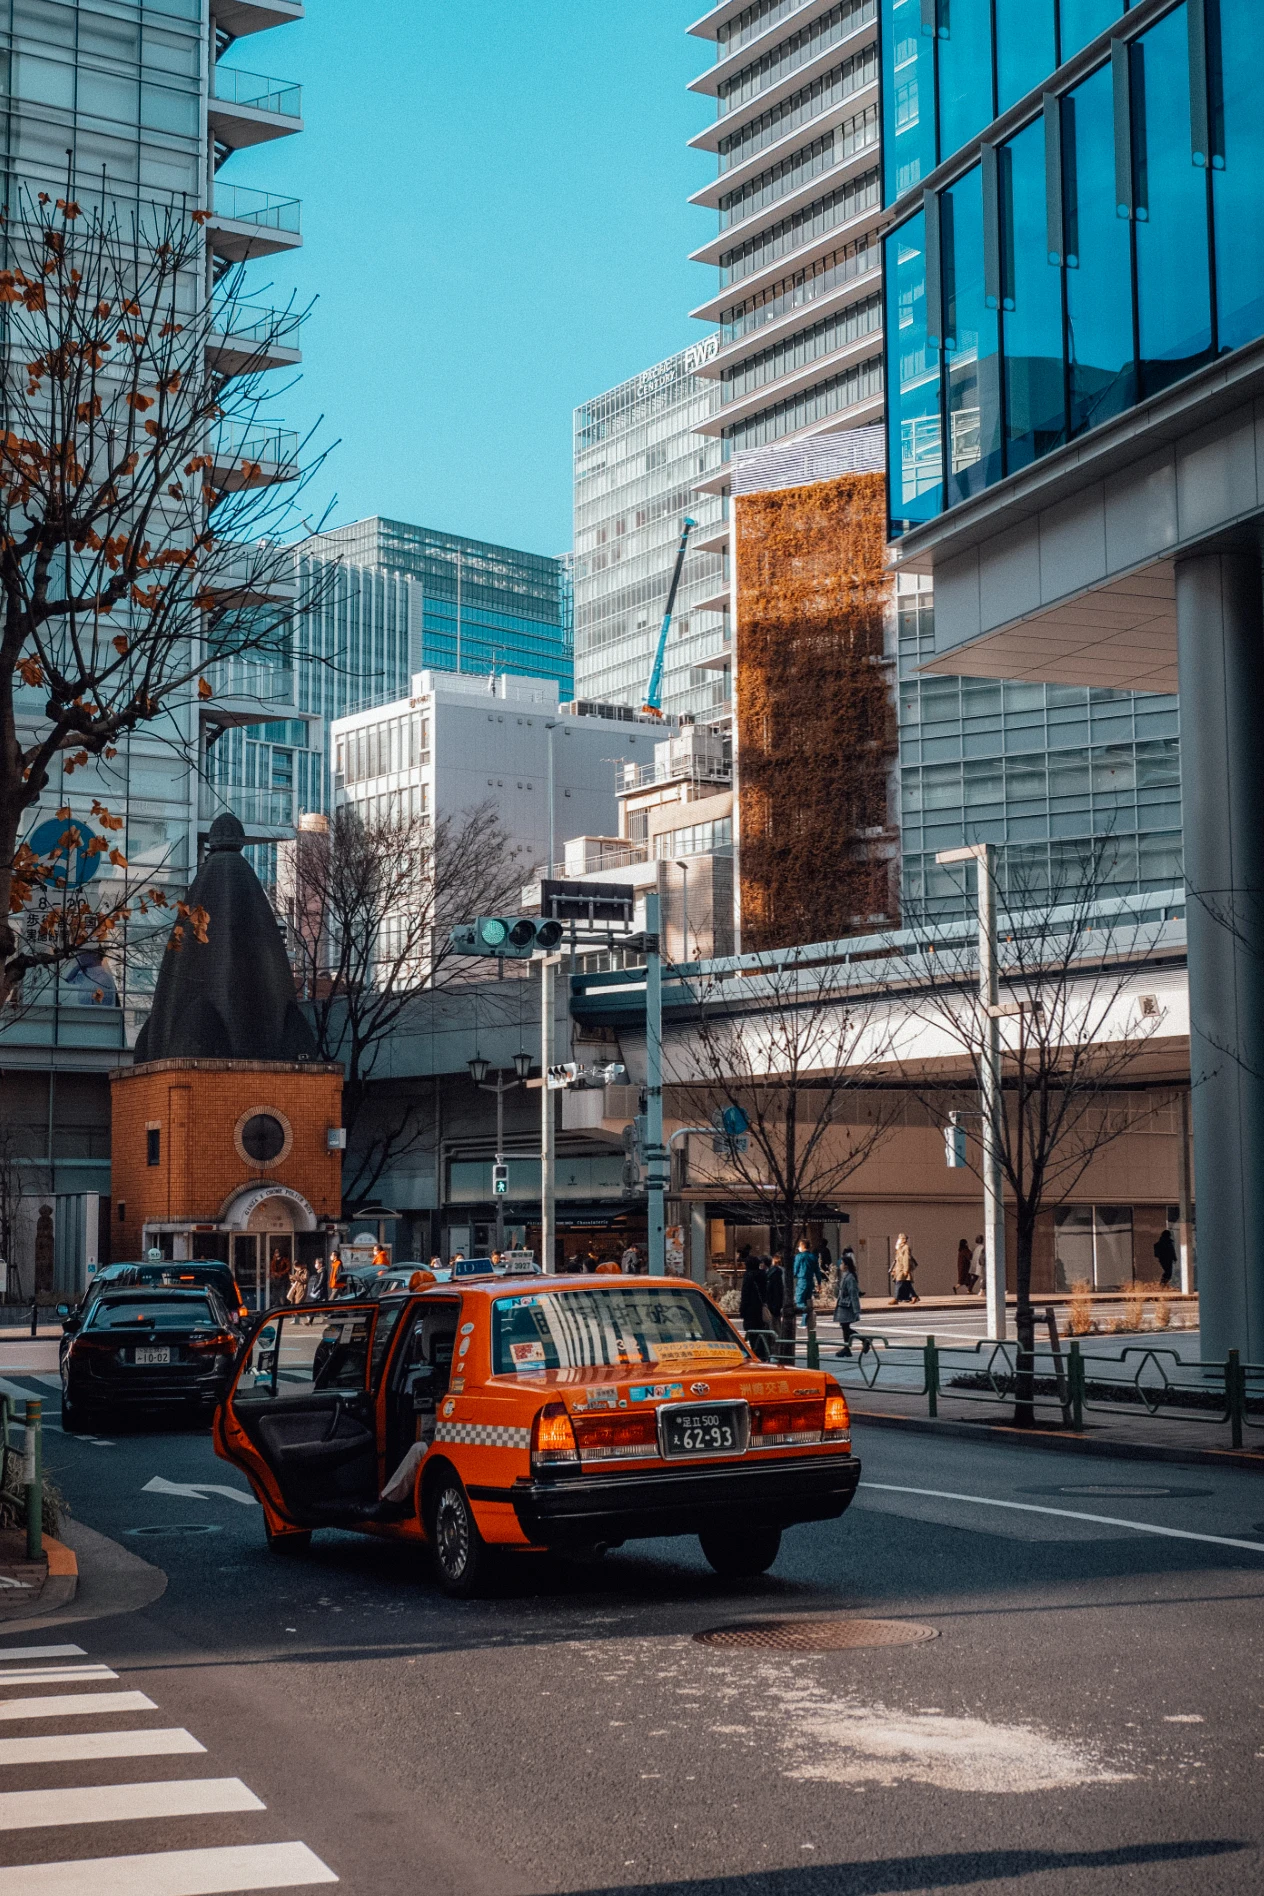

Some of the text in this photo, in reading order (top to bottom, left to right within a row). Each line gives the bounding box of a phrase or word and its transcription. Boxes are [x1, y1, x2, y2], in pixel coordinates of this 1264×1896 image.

[684, 338, 718, 372] FWD
[637, 371, 676, 397] CENTURY
[683, 1426, 733, 1449] 62-93
